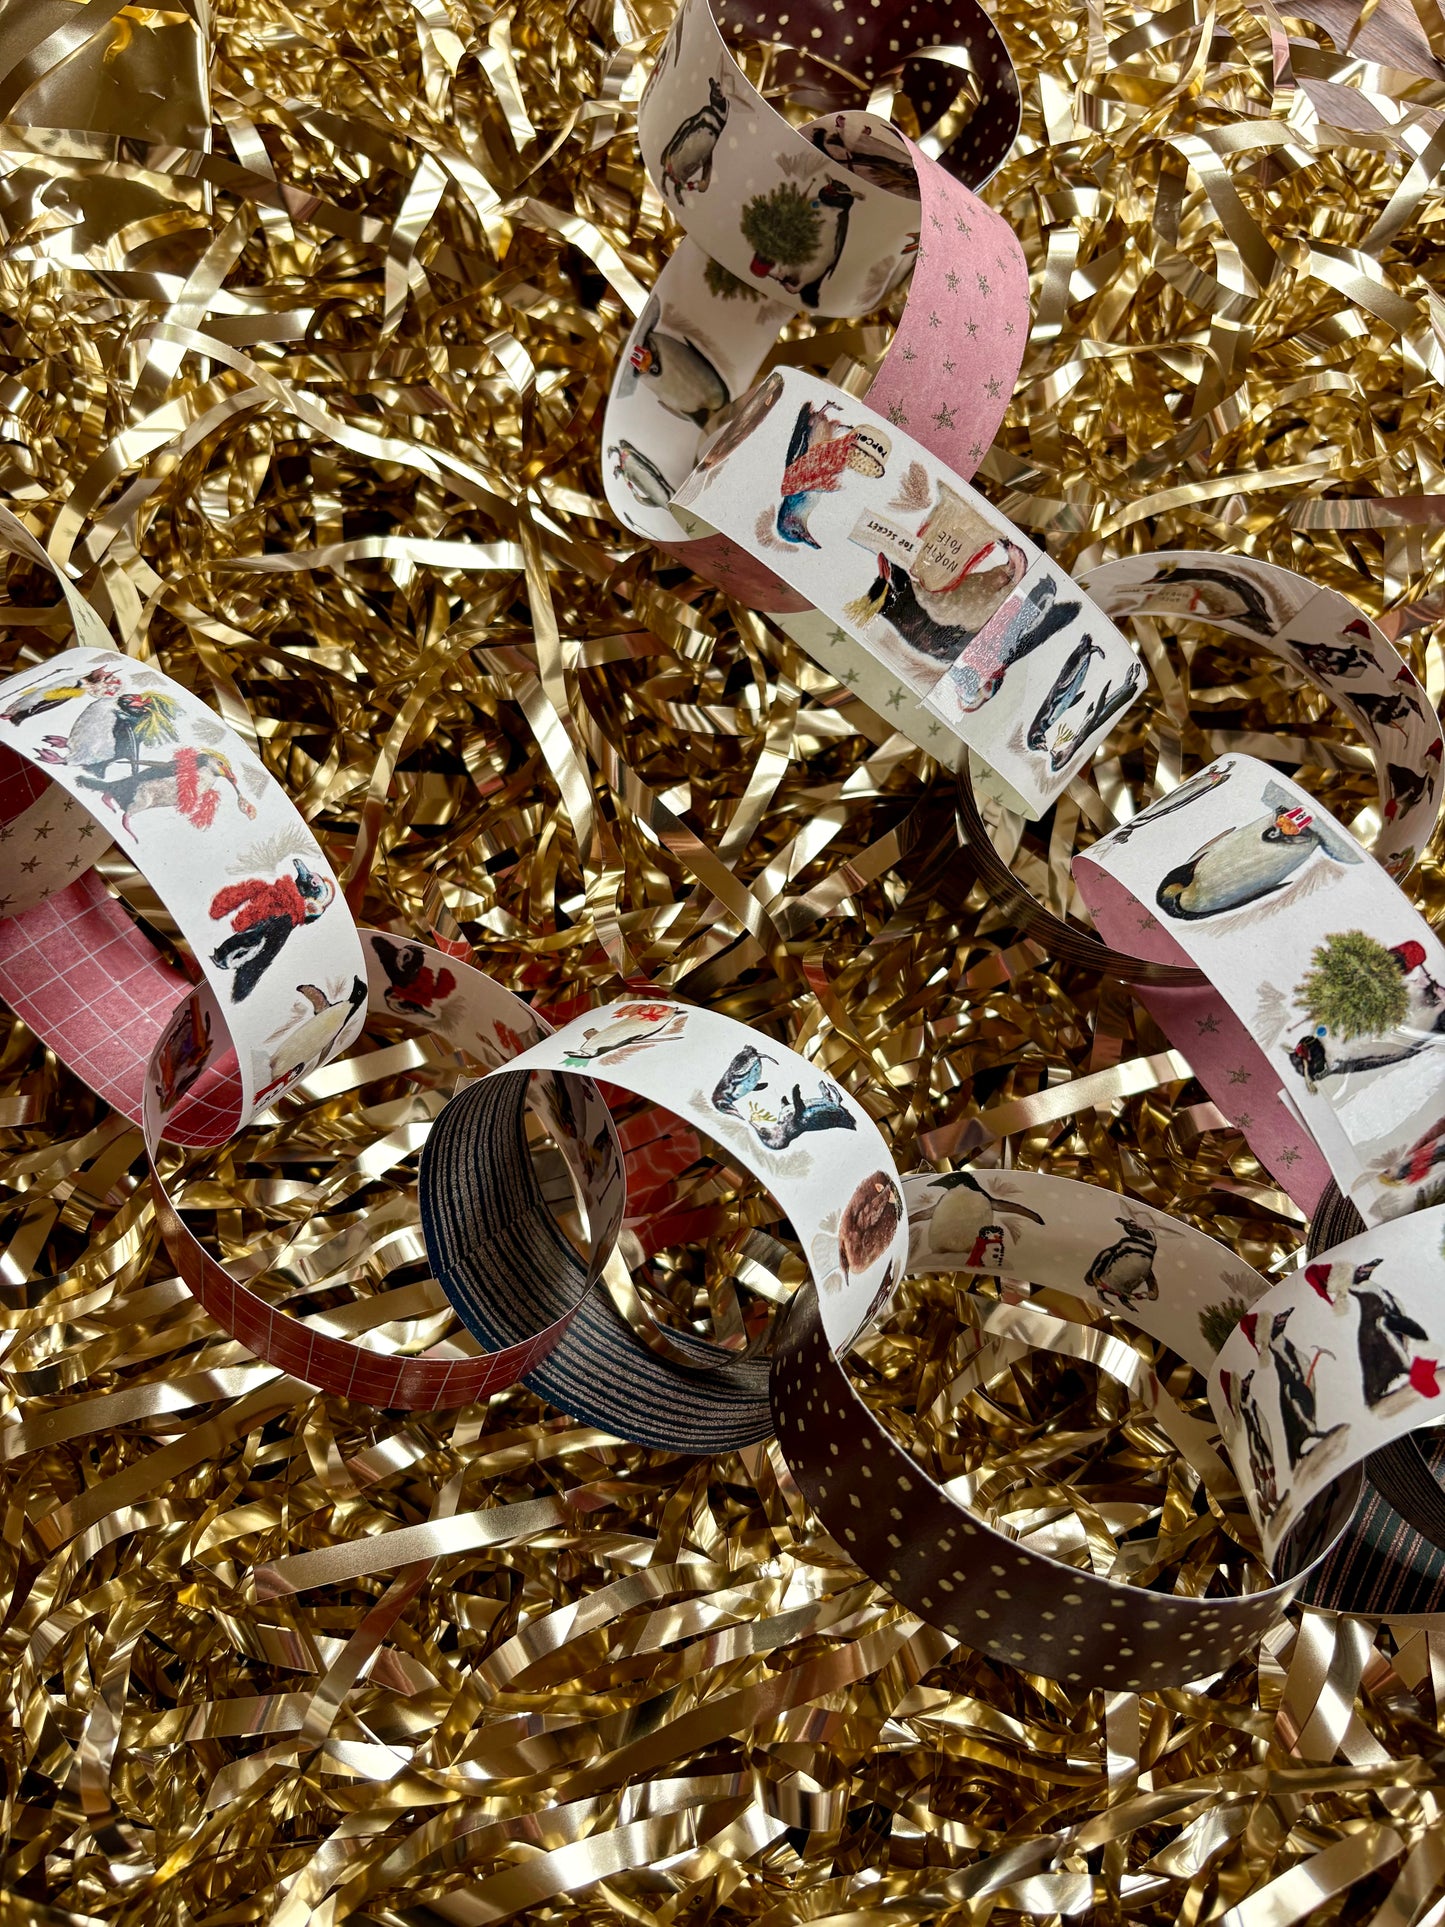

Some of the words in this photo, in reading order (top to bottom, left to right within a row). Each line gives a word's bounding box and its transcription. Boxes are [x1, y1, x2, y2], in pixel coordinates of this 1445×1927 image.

[867, 520, 898, 540] SECRET
[898, 540, 914, 552] TOP
[937, 531, 962, 555] POLE
[923, 542, 959, 573] NORTH
